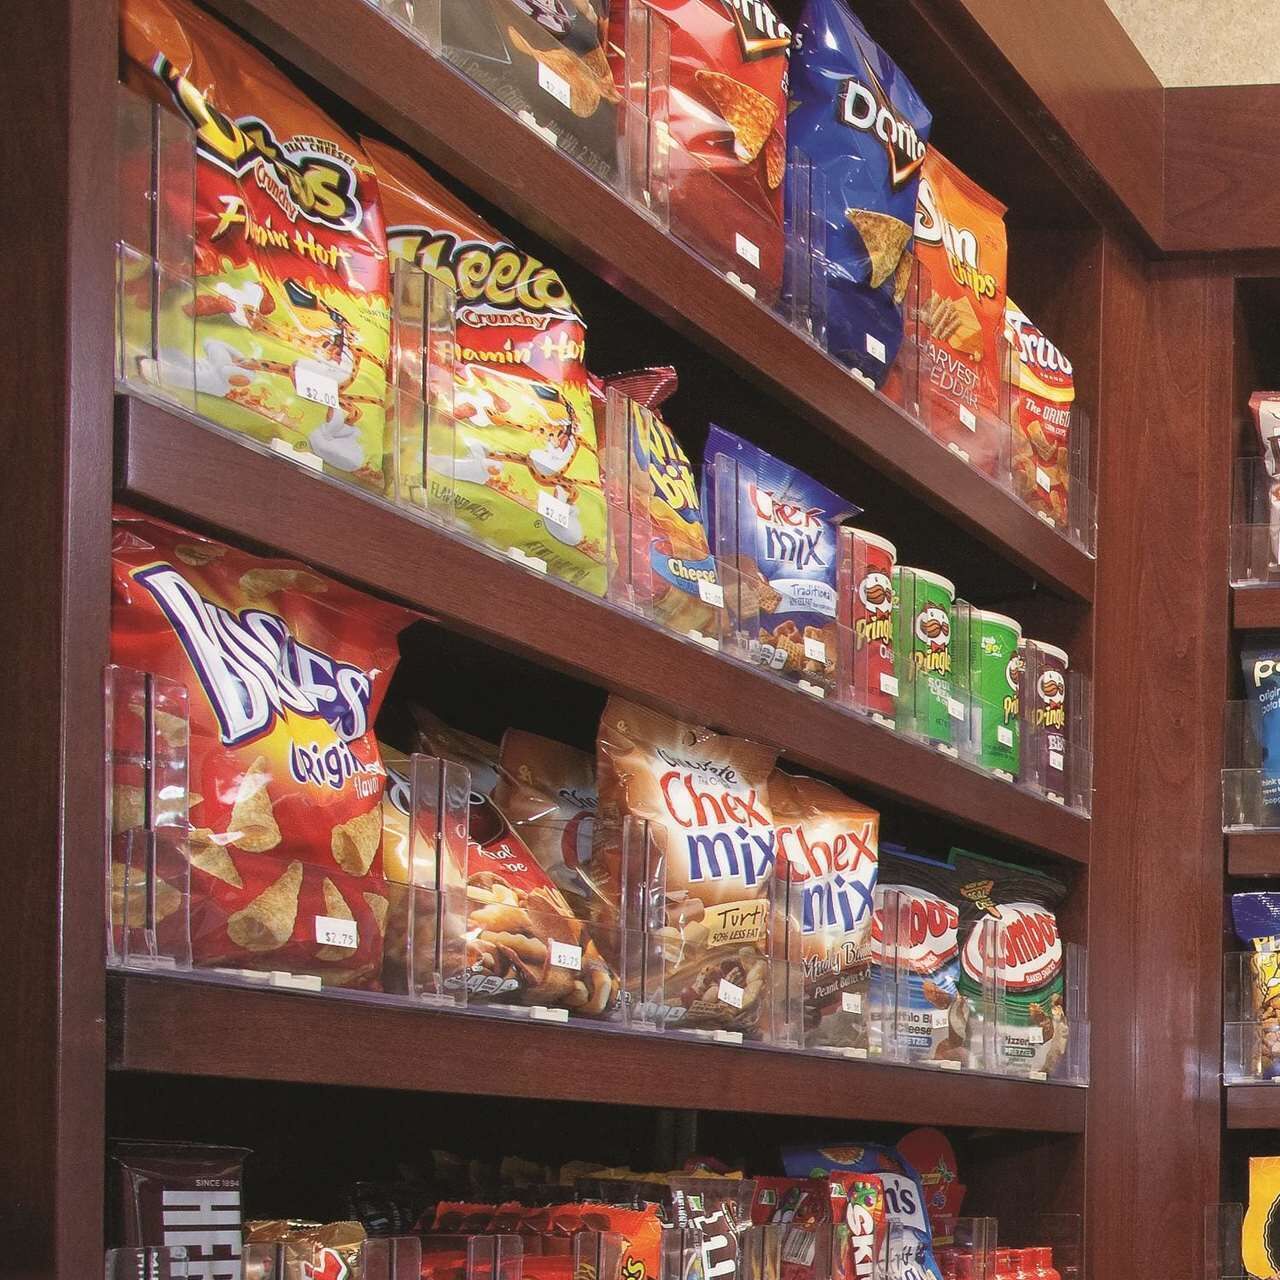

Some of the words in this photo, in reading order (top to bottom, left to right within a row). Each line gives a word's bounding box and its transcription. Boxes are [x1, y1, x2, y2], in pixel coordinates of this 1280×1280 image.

[254, 160, 299, 222] Crunchy
[950, 256, 997, 302] Chips
[461, 309, 549, 331] Crunchy
[667, 557, 715, 584] Cheese
[765, 528, 829, 570] mix
[659, 771, 770, 832] Chex
[688, 825, 775, 887] mix
[776, 823, 878, 882] Chex
[801, 874, 876, 933] mix
[325, 931, 353, 944] $2.75
